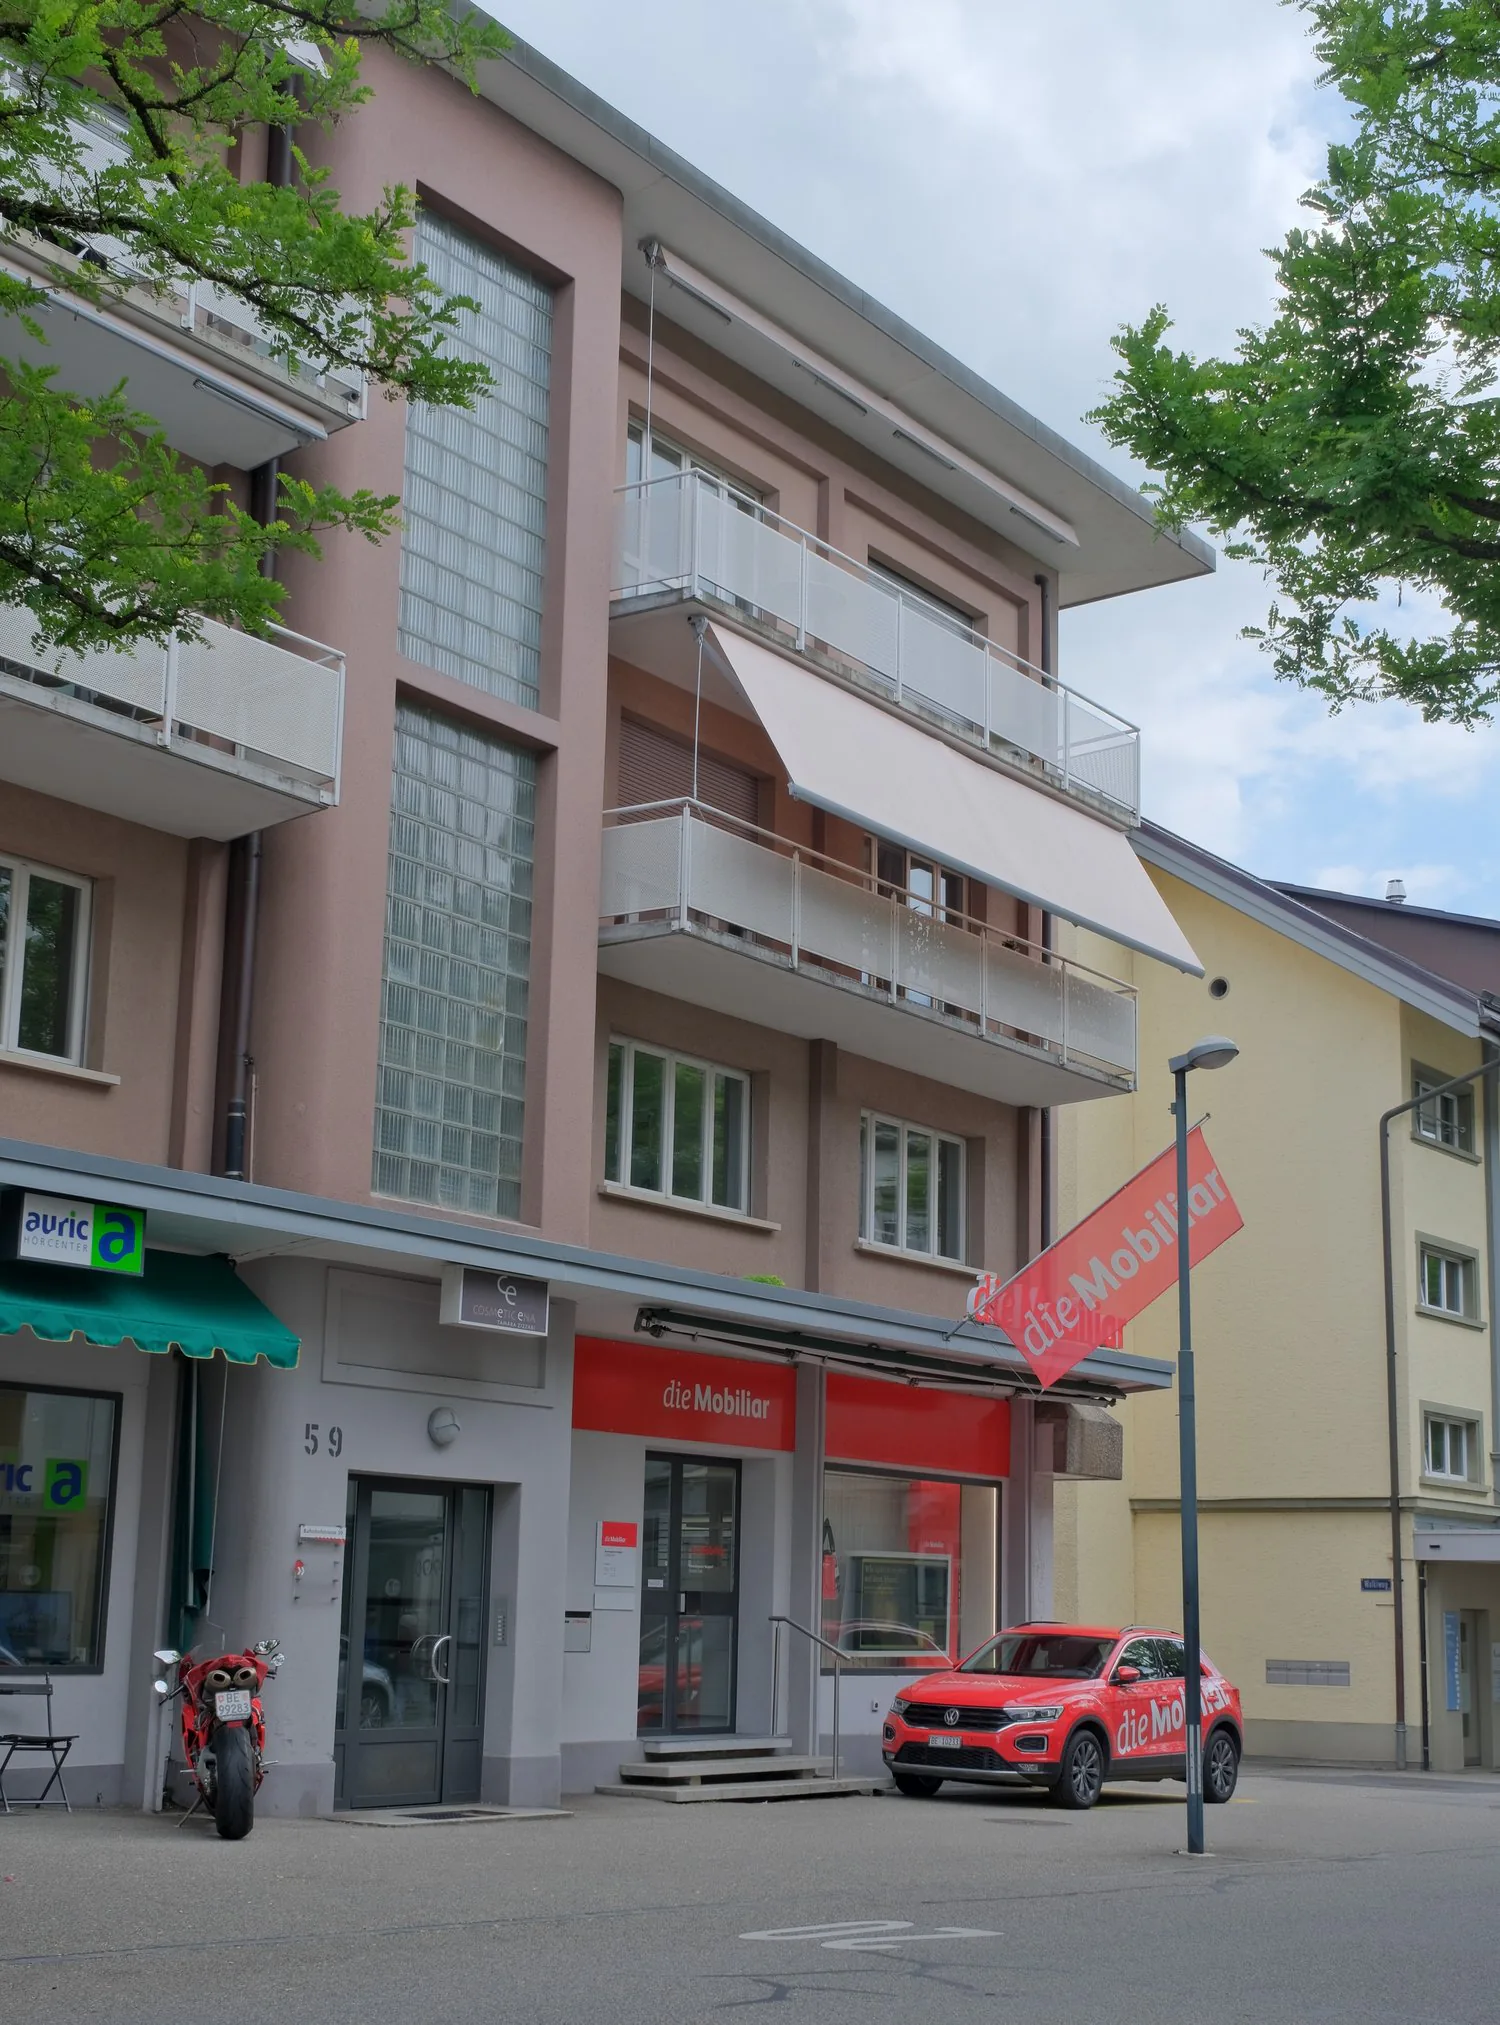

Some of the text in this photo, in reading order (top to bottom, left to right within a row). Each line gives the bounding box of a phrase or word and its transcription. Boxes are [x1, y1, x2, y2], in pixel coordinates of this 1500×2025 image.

[25, 1210, 89, 1241] auric
[1024, 1296, 1080, 1356] die
[663, 1380, 770, 1419] die Mobiliar
[304, 1423, 343, 1458] 59
[219, 1703, 249, 1715] 99283
[226, 1692, 240, 1703] BE
[1117, 1677, 1231, 1755] die Moliar
